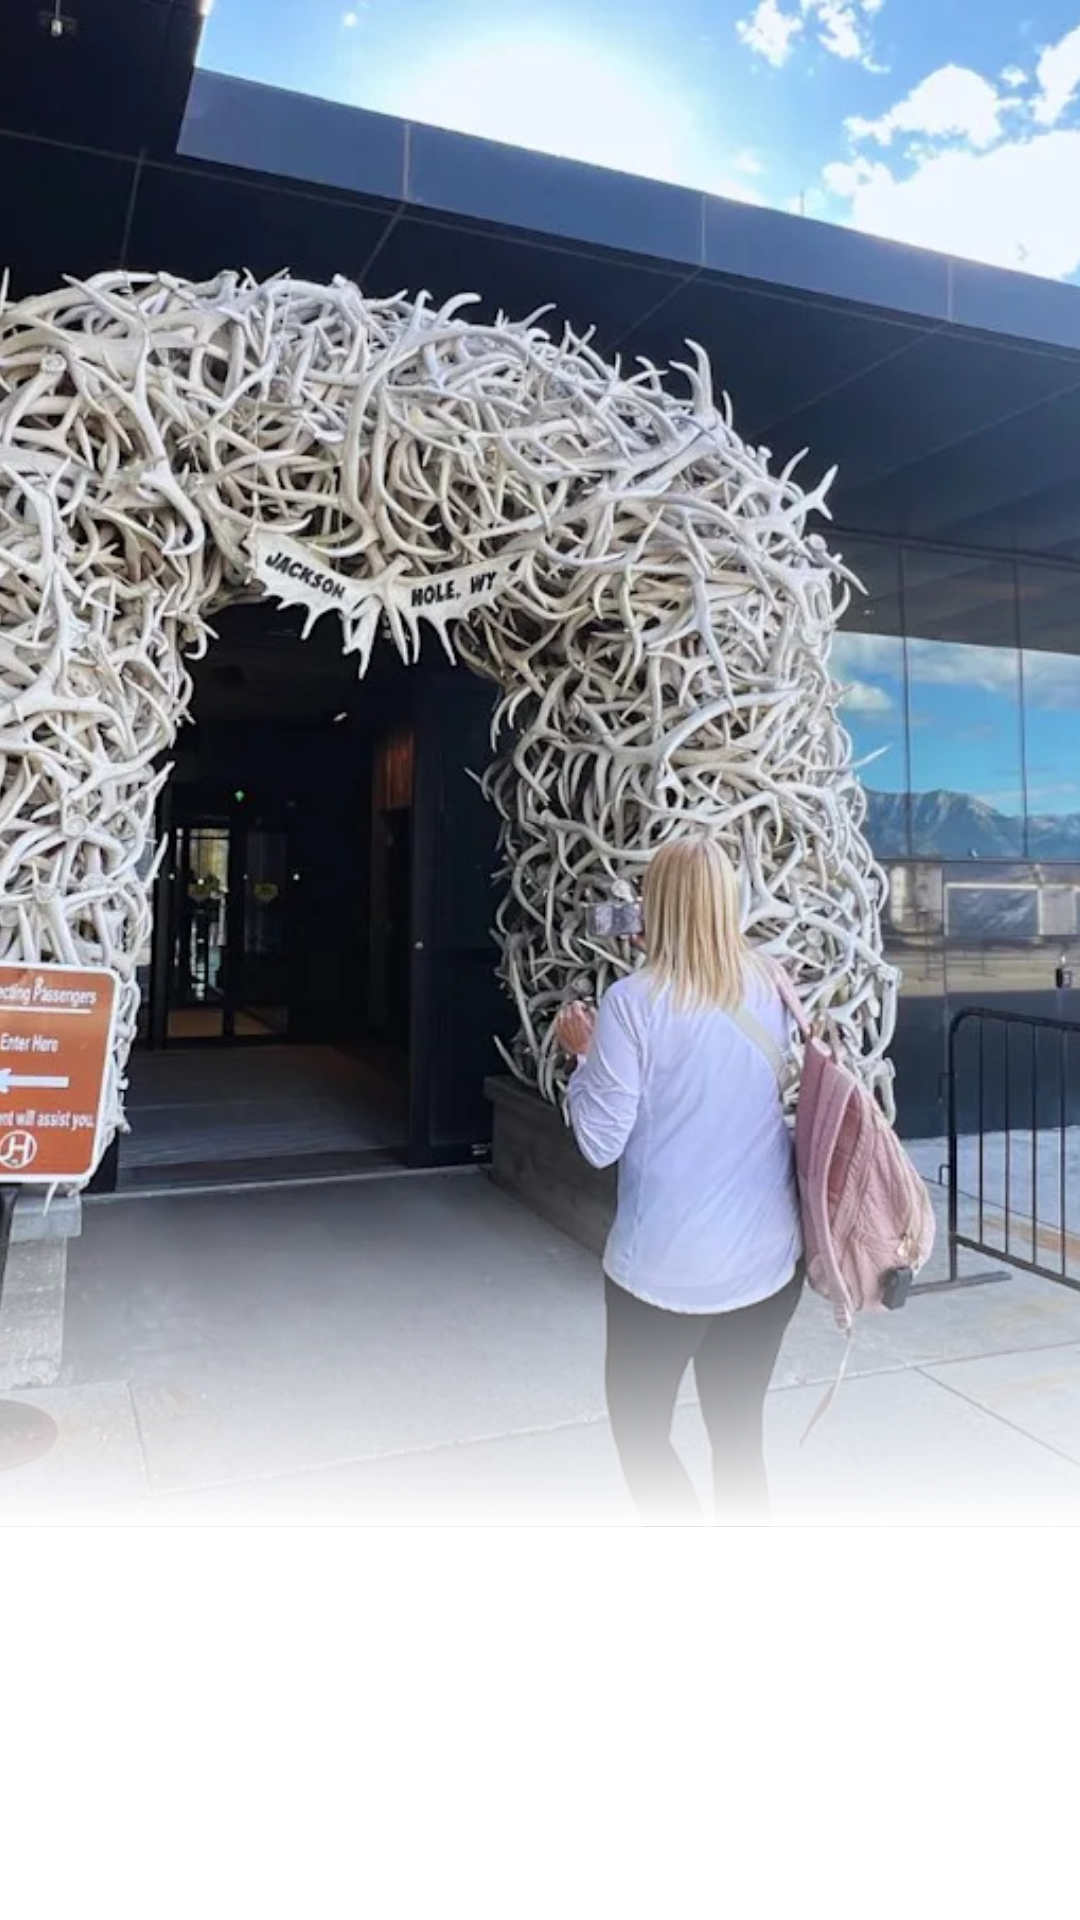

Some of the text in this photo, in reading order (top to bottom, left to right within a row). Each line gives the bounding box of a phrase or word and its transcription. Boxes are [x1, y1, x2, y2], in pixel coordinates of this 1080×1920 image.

[264, 551, 498, 607] JACKSON HOLE, WY
[32, 982, 97, 1007] Passengers
[0, 1032, 59, 1053] Enter Here
[15, 1109, 36, 1126] will
[36, 1110, 71, 1128] assist
